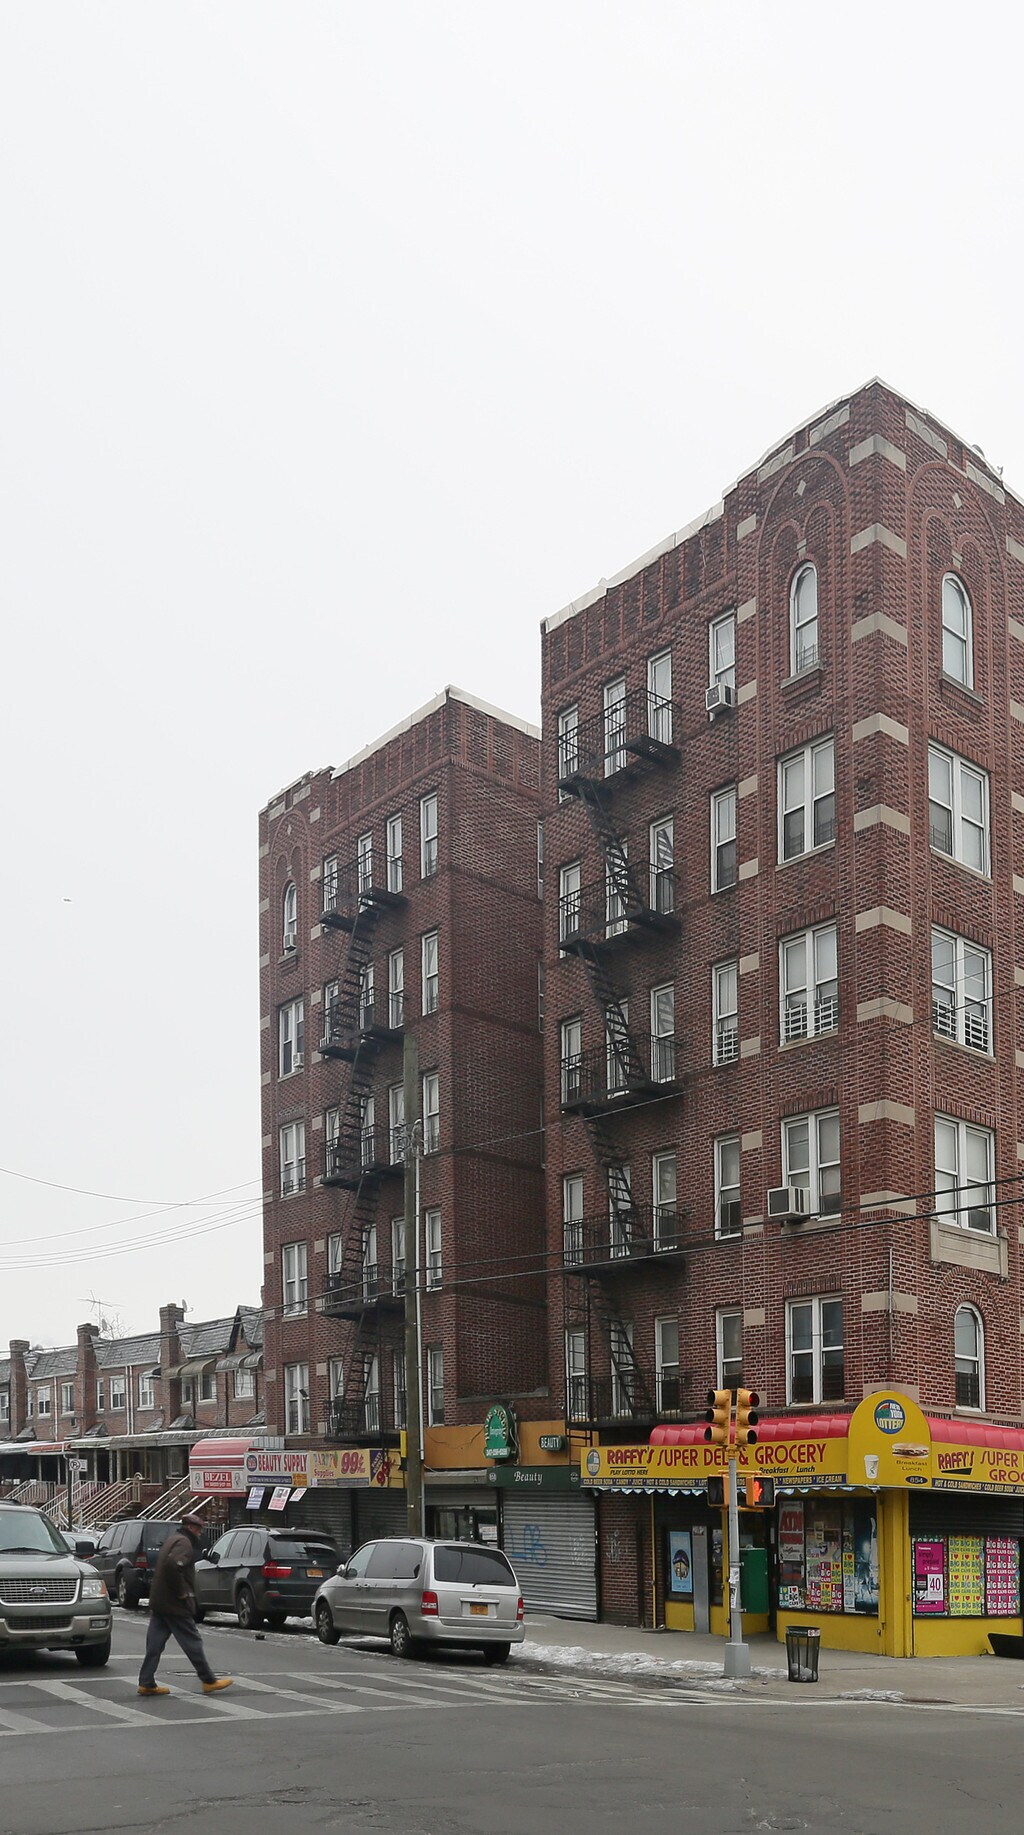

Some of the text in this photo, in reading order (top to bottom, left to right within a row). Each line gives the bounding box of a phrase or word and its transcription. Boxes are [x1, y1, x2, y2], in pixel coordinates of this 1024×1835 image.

[890, 1410, 903, 1418] YORK
[877, 1418, 903, 1429] LOTTERY
[541, 1438, 560, 1448] BEAUTY
[608, 1446, 654, 1464] RAFFY'S
[657, 1449, 698, 1466] SUPER
[704, 1448, 728, 1465] DEL
[739, 1448, 748, 1465] &
[755, 1444, 826, 1464] GROCERY
[938, 1451, 974, 1469] RAFFY'S
[980, 1451, 1018, 1467] SUPER
[258, 1454, 282, 1472] BEAUTY
[284, 1454, 307, 1472] SUPPLY
[205, 1473, 231, 1481] BEZEL
[314, 1469, 334, 1477] Supplies
[514, 1471, 543, 1485] Beauty
[825, 1476, 842, 1484] CREAM
[958, 1482, 981, 1490] SANDWICHES
